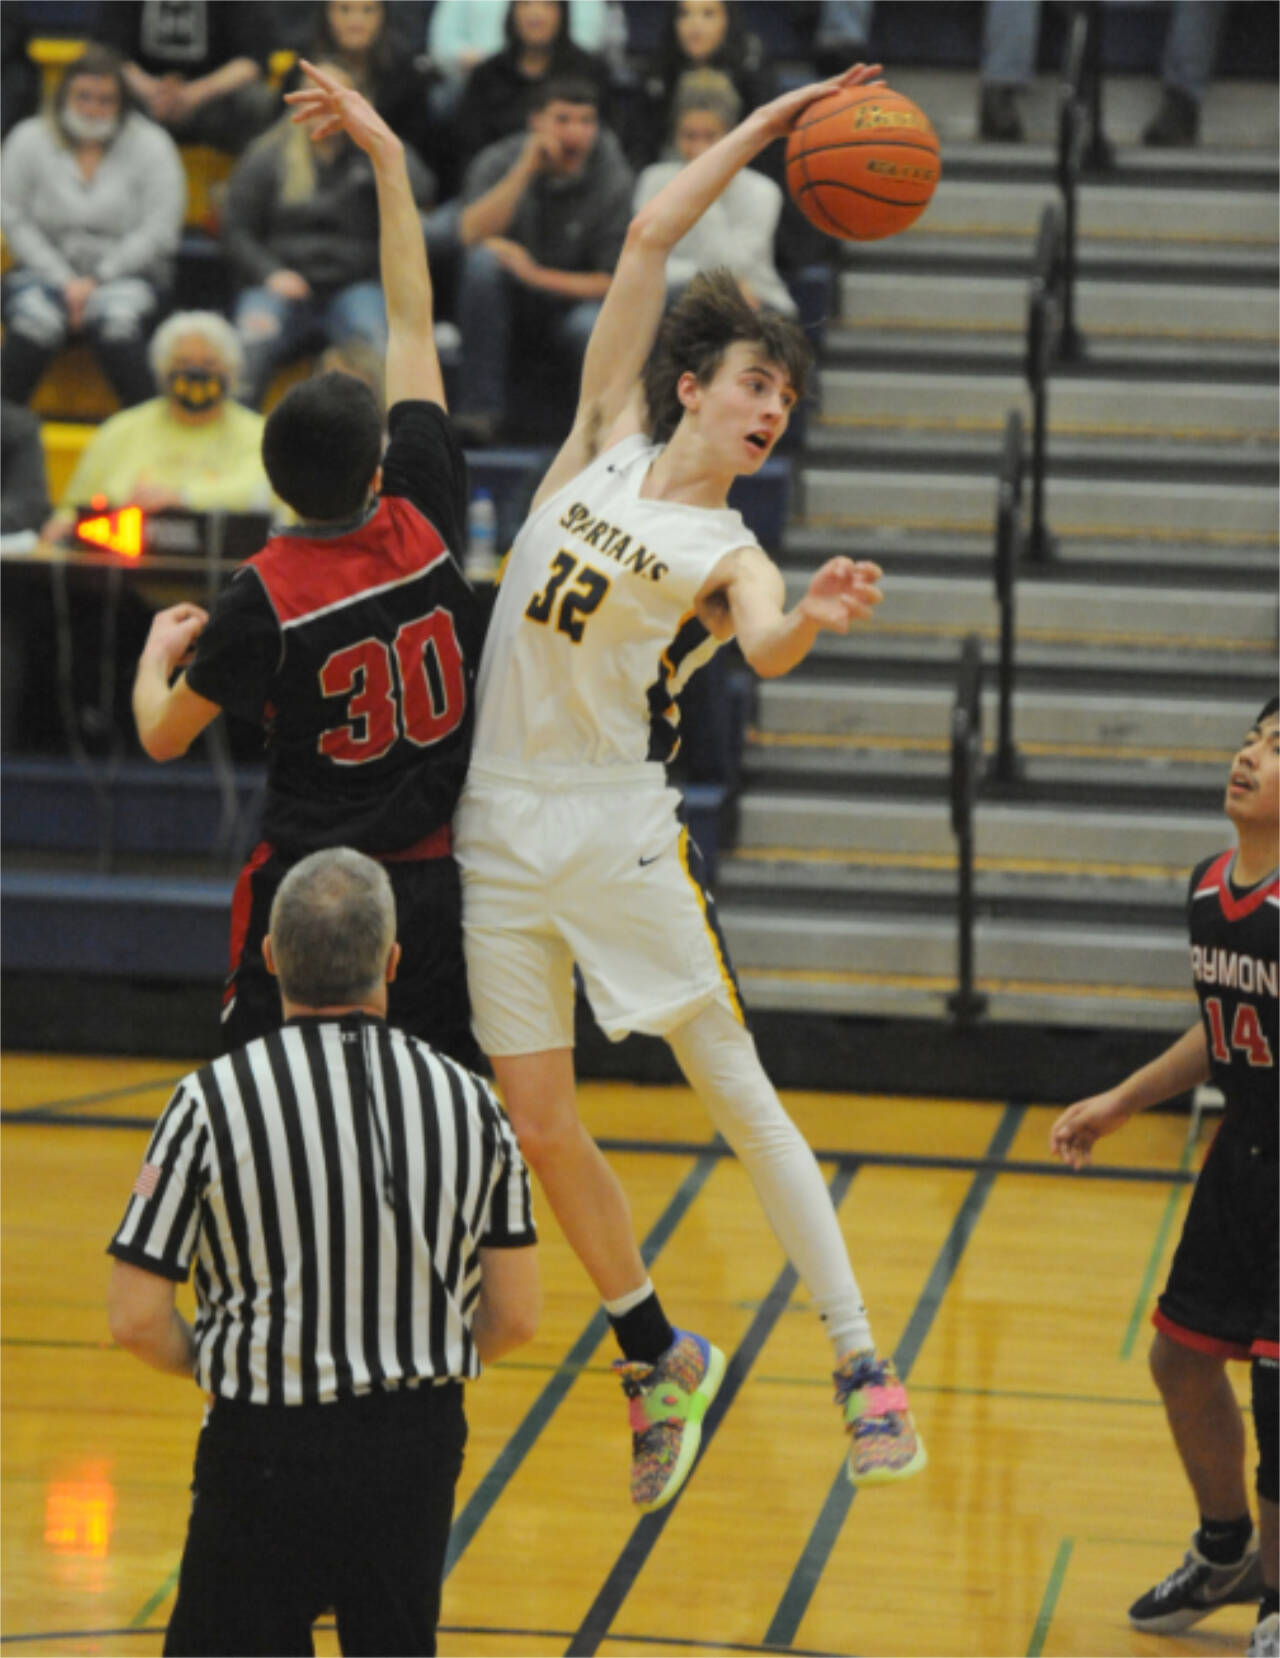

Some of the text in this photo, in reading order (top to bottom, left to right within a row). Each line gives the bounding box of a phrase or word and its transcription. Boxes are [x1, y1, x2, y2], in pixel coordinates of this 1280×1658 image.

[559, 501, 670, 582] SPARTANS
[524, 548, 612, 646] 32
[317, 604, 466, 766] 30
[1205, 996, 1273, 1068] 14
